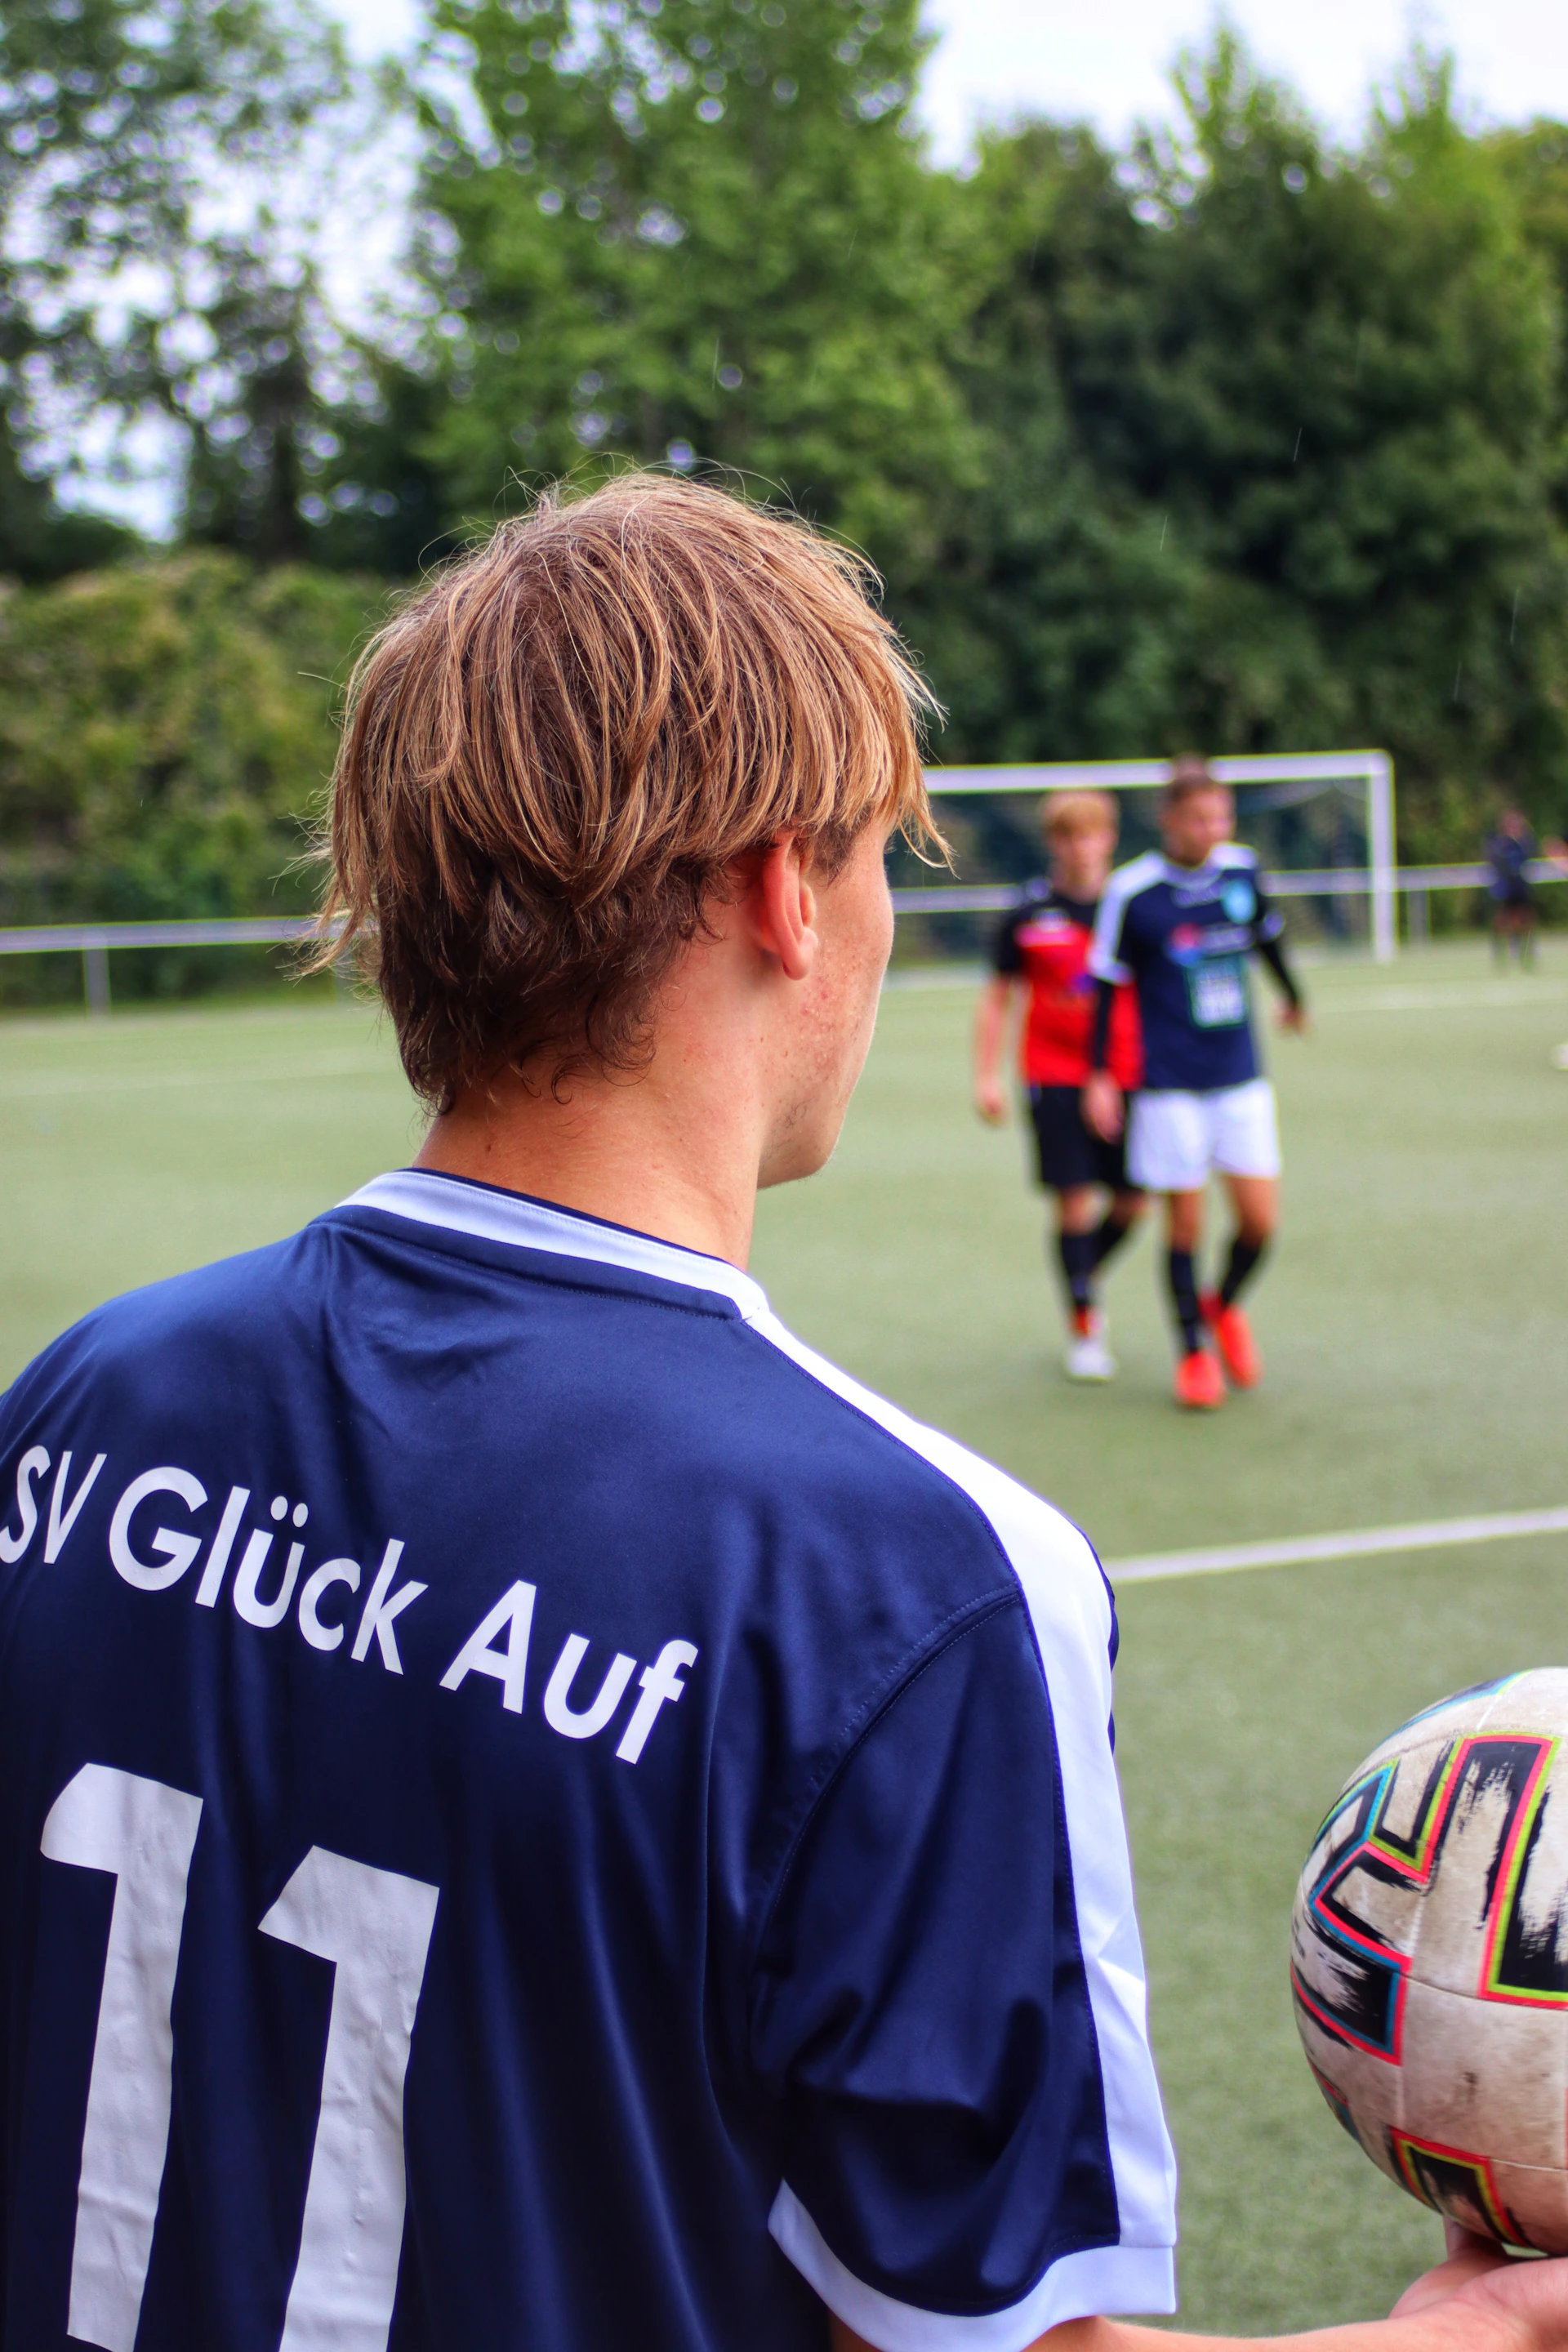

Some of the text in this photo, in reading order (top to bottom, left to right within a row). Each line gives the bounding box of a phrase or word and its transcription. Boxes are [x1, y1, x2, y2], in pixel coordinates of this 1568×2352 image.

[0, 1445, 699, 1765] SV Glück Auf
[39, 1762, 441, 2352] 11
